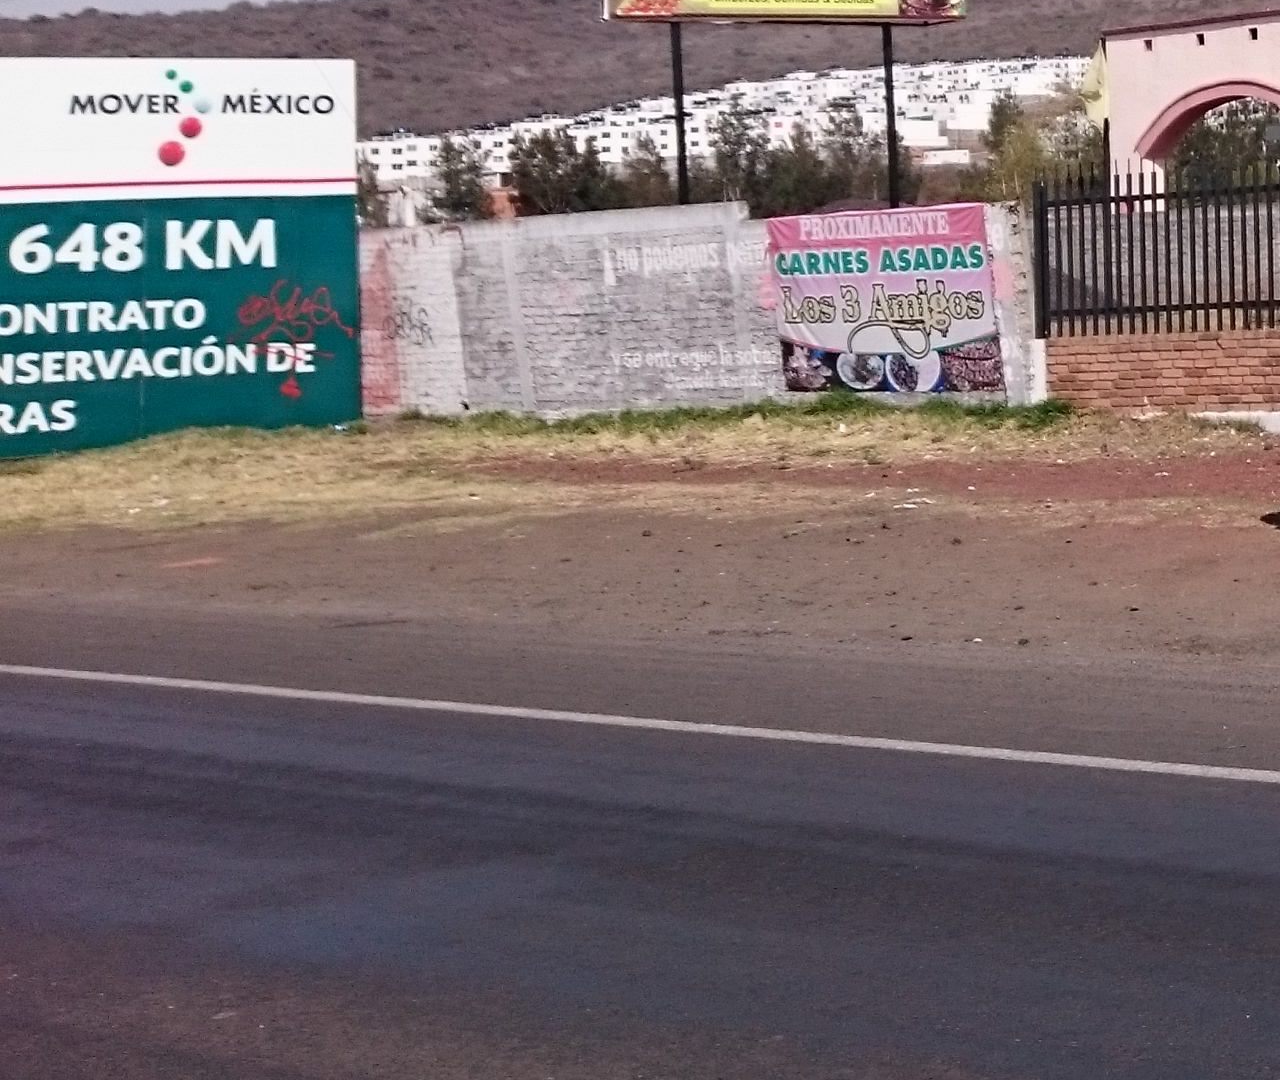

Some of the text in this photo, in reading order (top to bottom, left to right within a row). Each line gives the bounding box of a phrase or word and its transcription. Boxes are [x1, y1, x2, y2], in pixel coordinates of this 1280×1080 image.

[69, 88, 335, 115] MOVER MÉXICO
[800, 211, 950, 241] PROXIMAMENTE
[8, 219, 278, 274] 648 KM
[775, 245, 984, 275] CARNES ASADAS
[781, 279, 985, 340] Los 3 Amigos
[266, 342, 317, 374] DE
